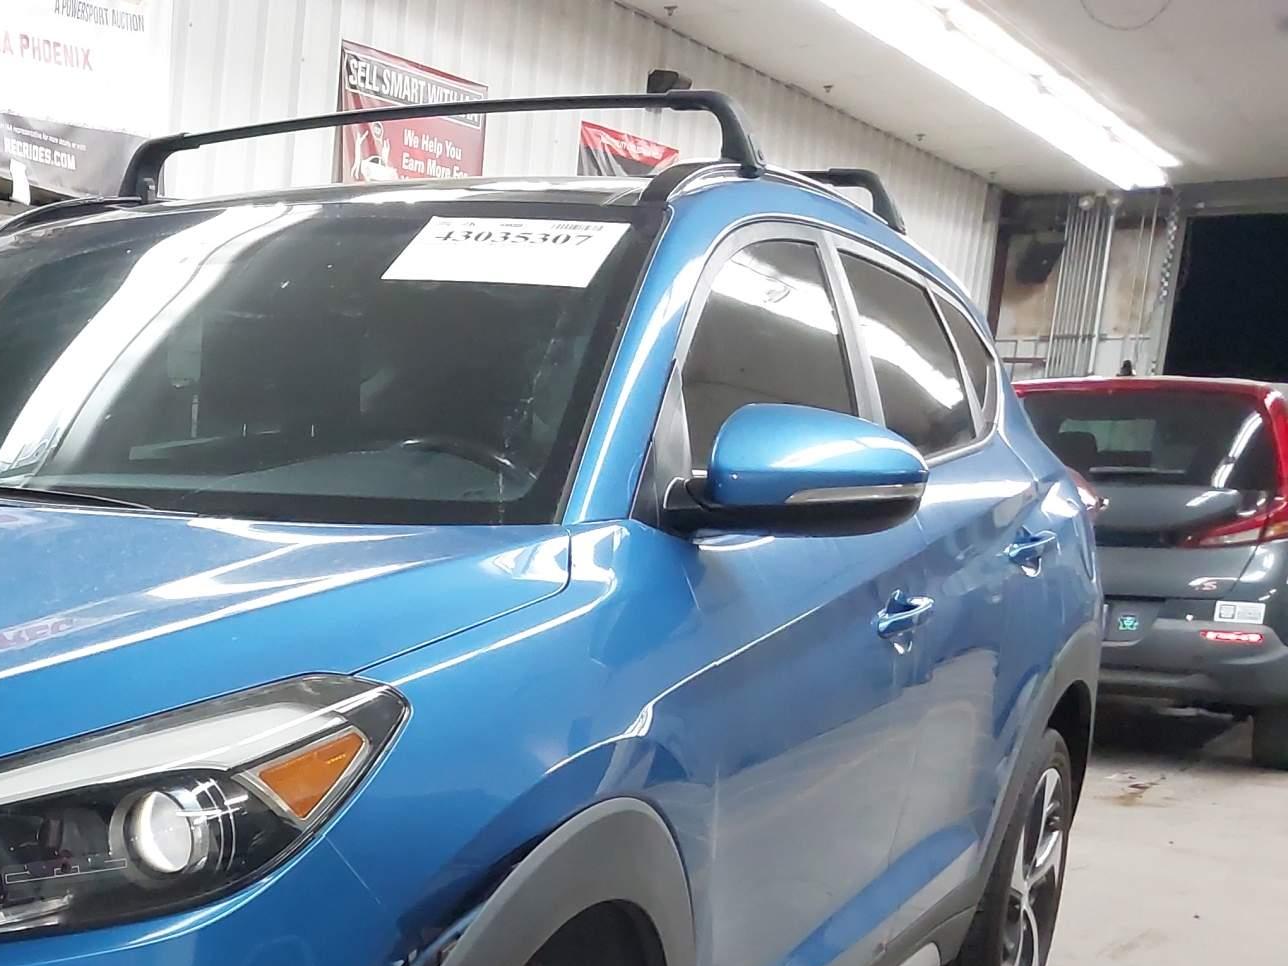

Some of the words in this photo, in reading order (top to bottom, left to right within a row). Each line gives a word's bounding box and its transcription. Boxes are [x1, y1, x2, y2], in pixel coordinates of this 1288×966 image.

[62, 0, 109, 25] POWERSPORT
[111, 9, 145, 32] AUCTION
[19, 34, 93, 71] PHOENIX
[349, 58, 379, 91] SELL
[381, 68, 425, 104] SMART
[3, 135, 77, 170] RECRIDES.COM
[403, 128, 419, 149] We
[421, 133, 443, 159] Help
[445, 140, 462, 161] You
[402, 152, 425, 174] Earn
[427, 158, 451, 178] More
[435, 230, 593, 246] 43035307
